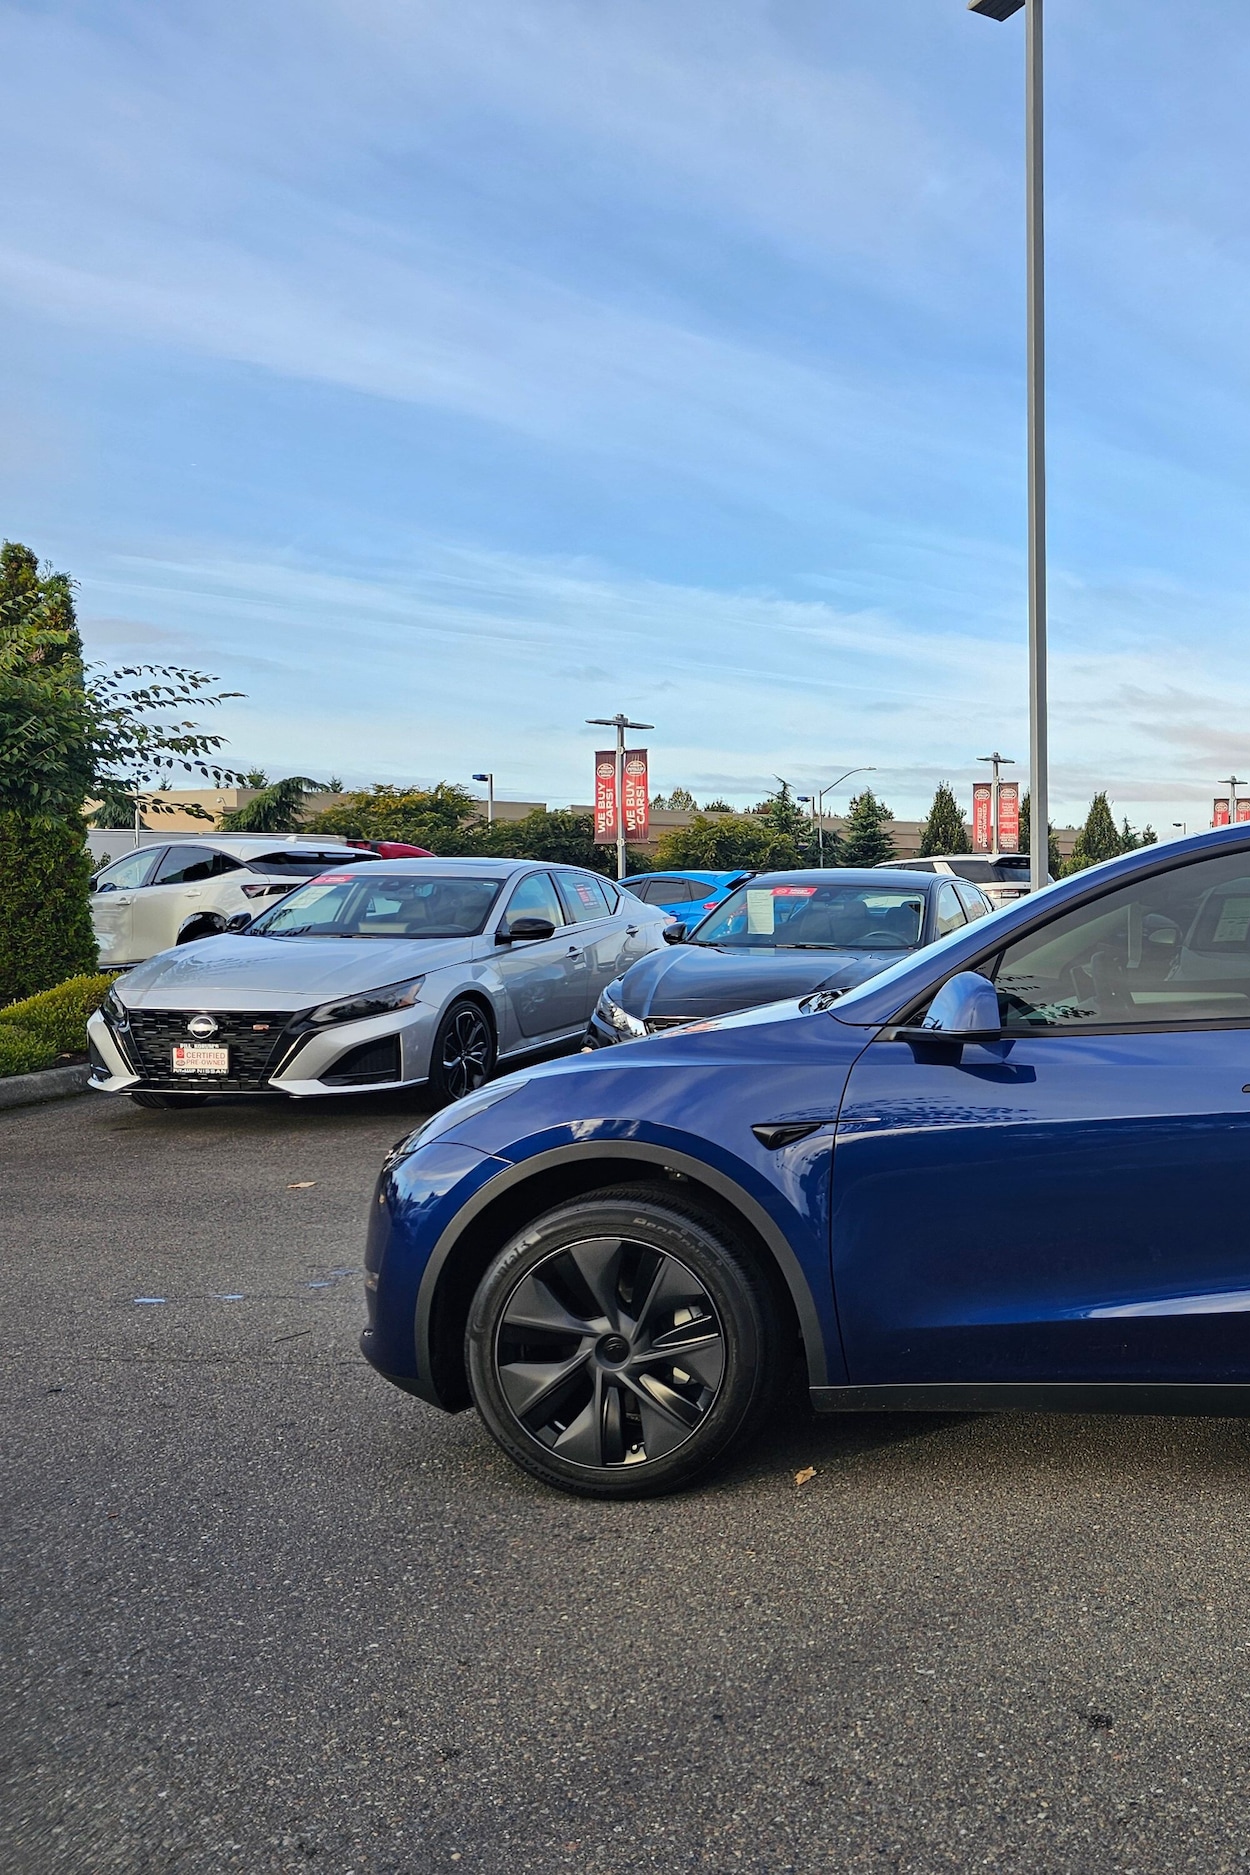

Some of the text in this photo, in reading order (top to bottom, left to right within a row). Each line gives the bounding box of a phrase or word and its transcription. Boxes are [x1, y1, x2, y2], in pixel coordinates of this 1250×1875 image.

[598, 782, 606, 809] BUY
[606, 788, 614, 826] CARS!
[626, 779, 636, 831] WE BUY
[636, 785, 646, 824] CARS!
[598, 812, 606, 833] WE
[186, 1051, 226, 1060] CERTIFIED
